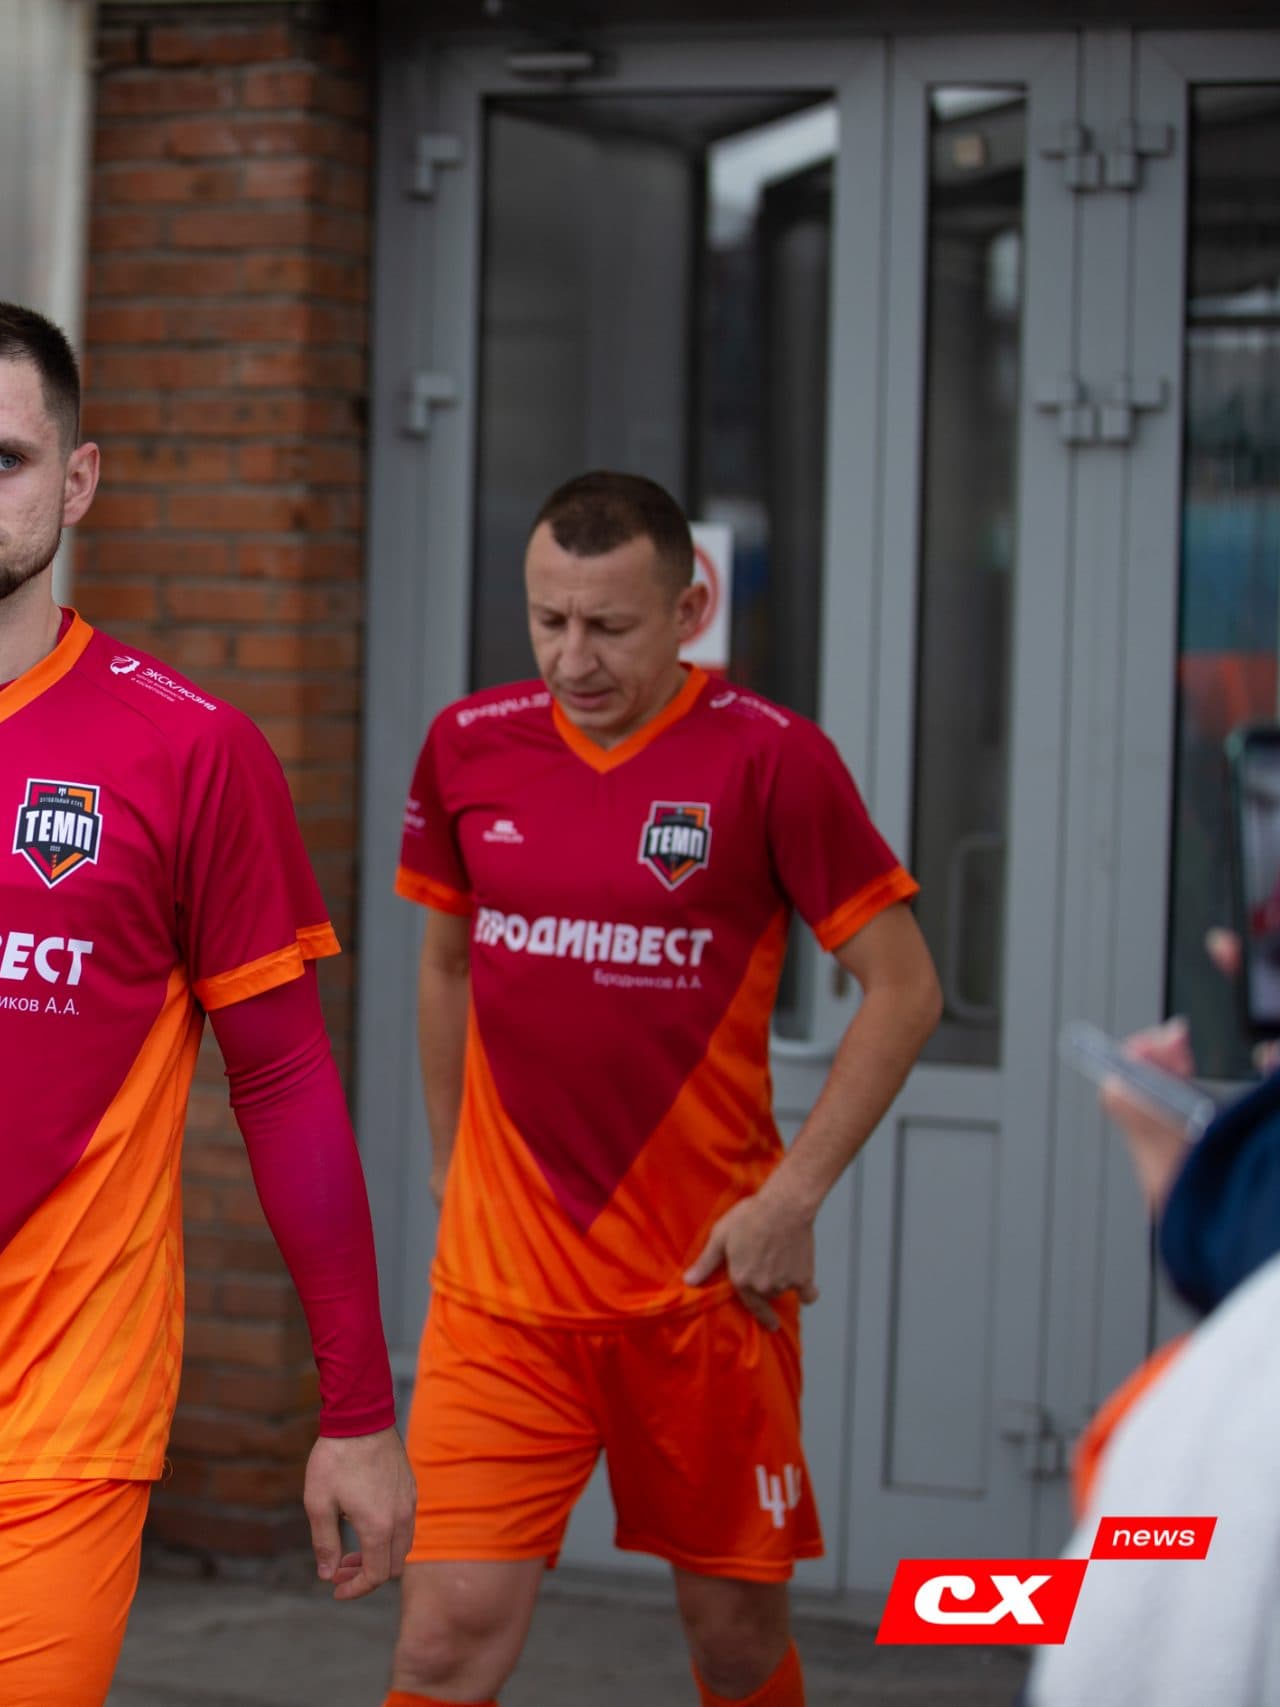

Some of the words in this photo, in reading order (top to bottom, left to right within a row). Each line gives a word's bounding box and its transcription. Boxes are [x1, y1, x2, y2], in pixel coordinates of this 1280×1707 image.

[25, 809, 94, 852] ТЕМП
[648, 825, 705, 860] ТЕМП
[474, 906, 714, 967] ПРОДИНВЕСТ
[44, 996, 80, 1016] А.А.
